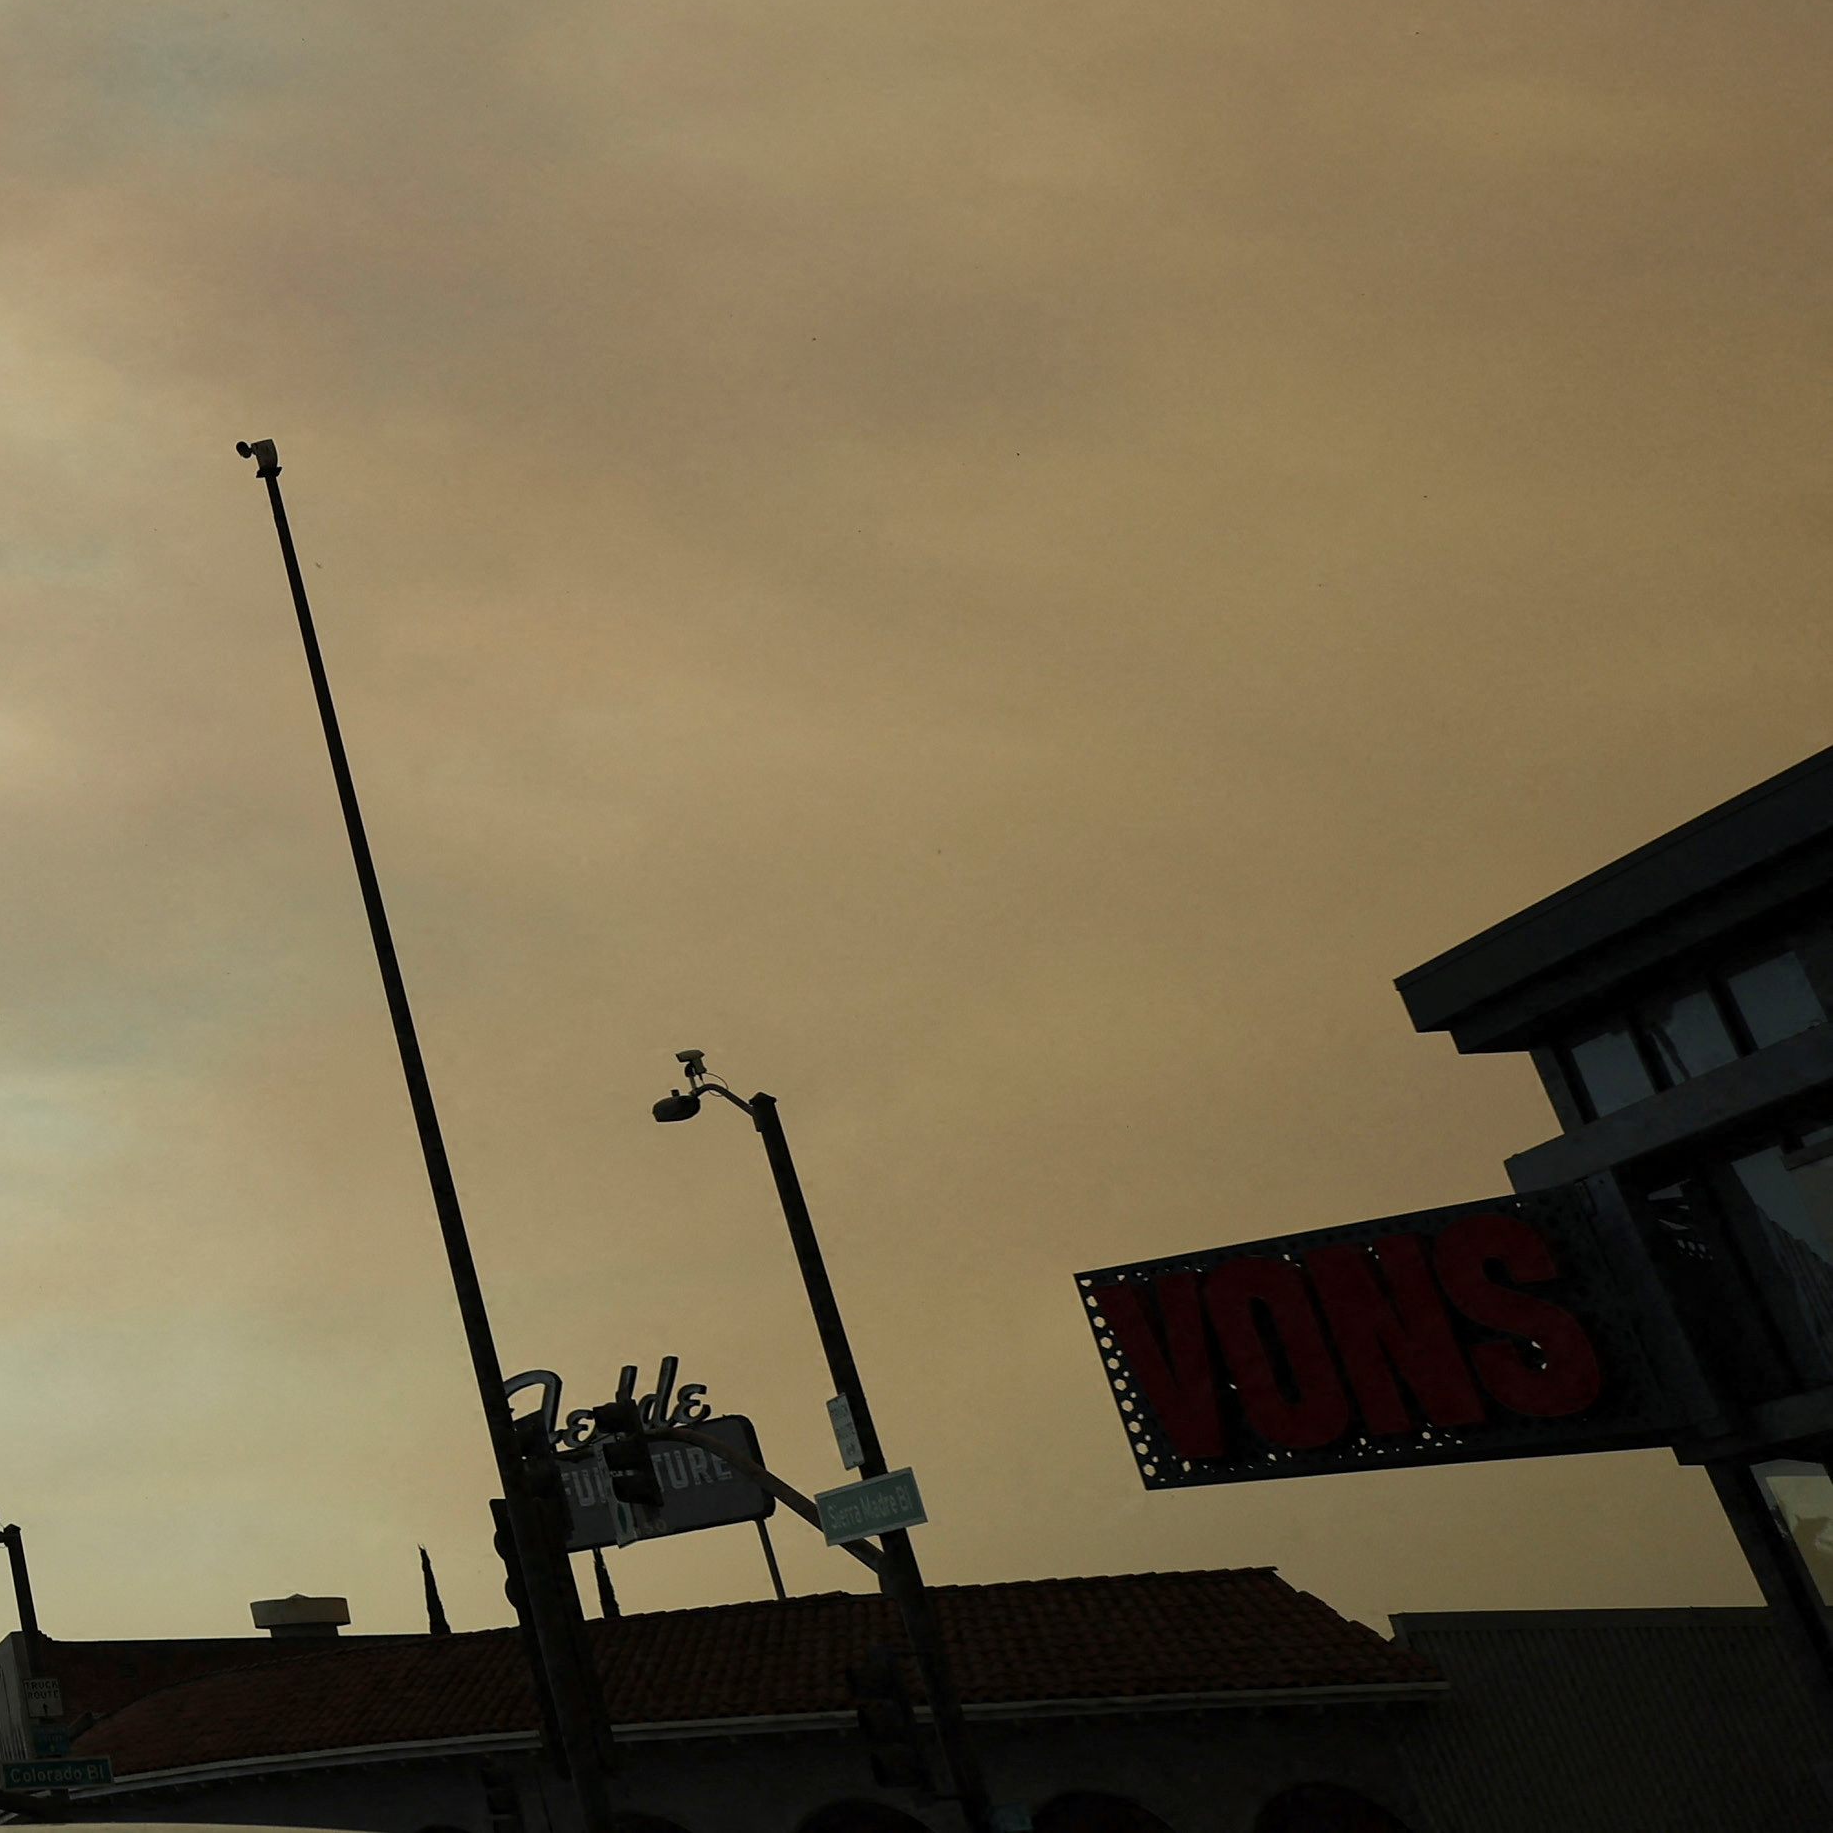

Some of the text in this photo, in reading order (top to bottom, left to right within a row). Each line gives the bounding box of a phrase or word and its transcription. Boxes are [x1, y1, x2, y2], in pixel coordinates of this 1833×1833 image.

[1093, 1214, 1603, 1459] VONS
[827, 1485, 914, 1529] Sierra Madre Bl
[25, 1680, 59, 1689] TRUCK
[27, 1690, 59, 1699] ROUTE
[10, 1764, 105, 1783] Colorado Bl
